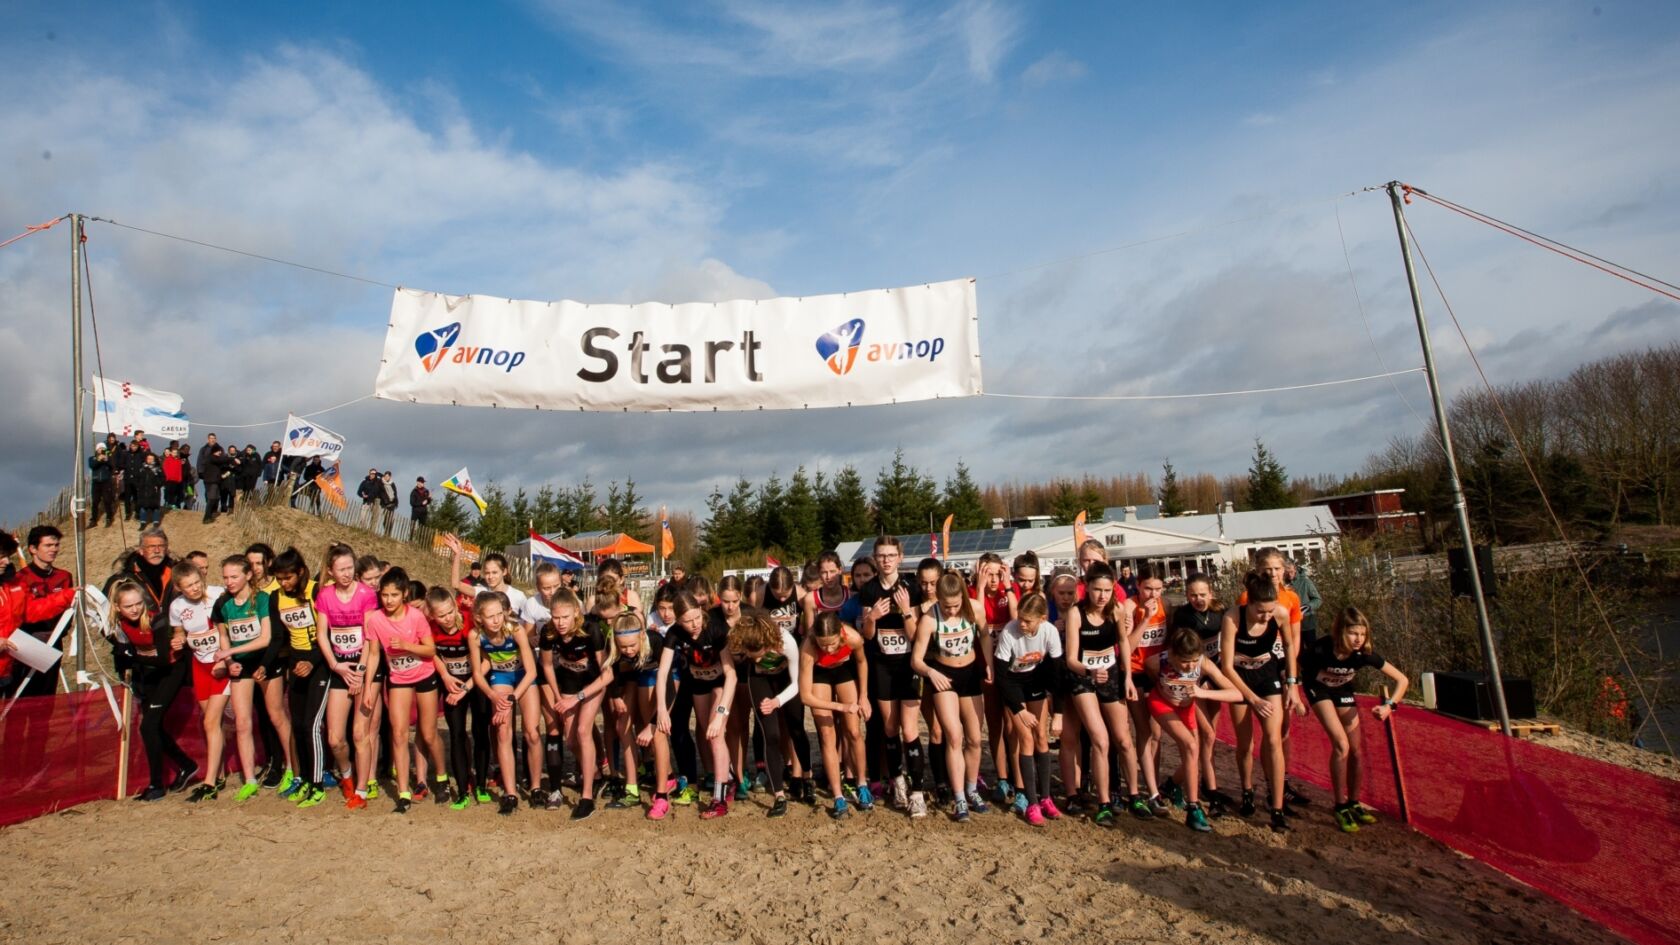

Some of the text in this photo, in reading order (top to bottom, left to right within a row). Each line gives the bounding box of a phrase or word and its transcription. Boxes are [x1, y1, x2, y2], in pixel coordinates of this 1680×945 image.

[577, 327, 763, 384] Start
[867, 337, 944, 362] avnop
[452, 346, 525, 372] avnop
[308, 438, 341, 452] avnop
[285, 610, 307, 622] 664
[232, 623, 254, 634] 661
[1143, 629, 1164, 640] 682
[193, 635, 216, 647] 649
[335, 634, 356, 643] 696
[882, 635, 906, 646] 650
[945, 636, 969, 648] 674
[1087, 655, 1110, 665] 678
